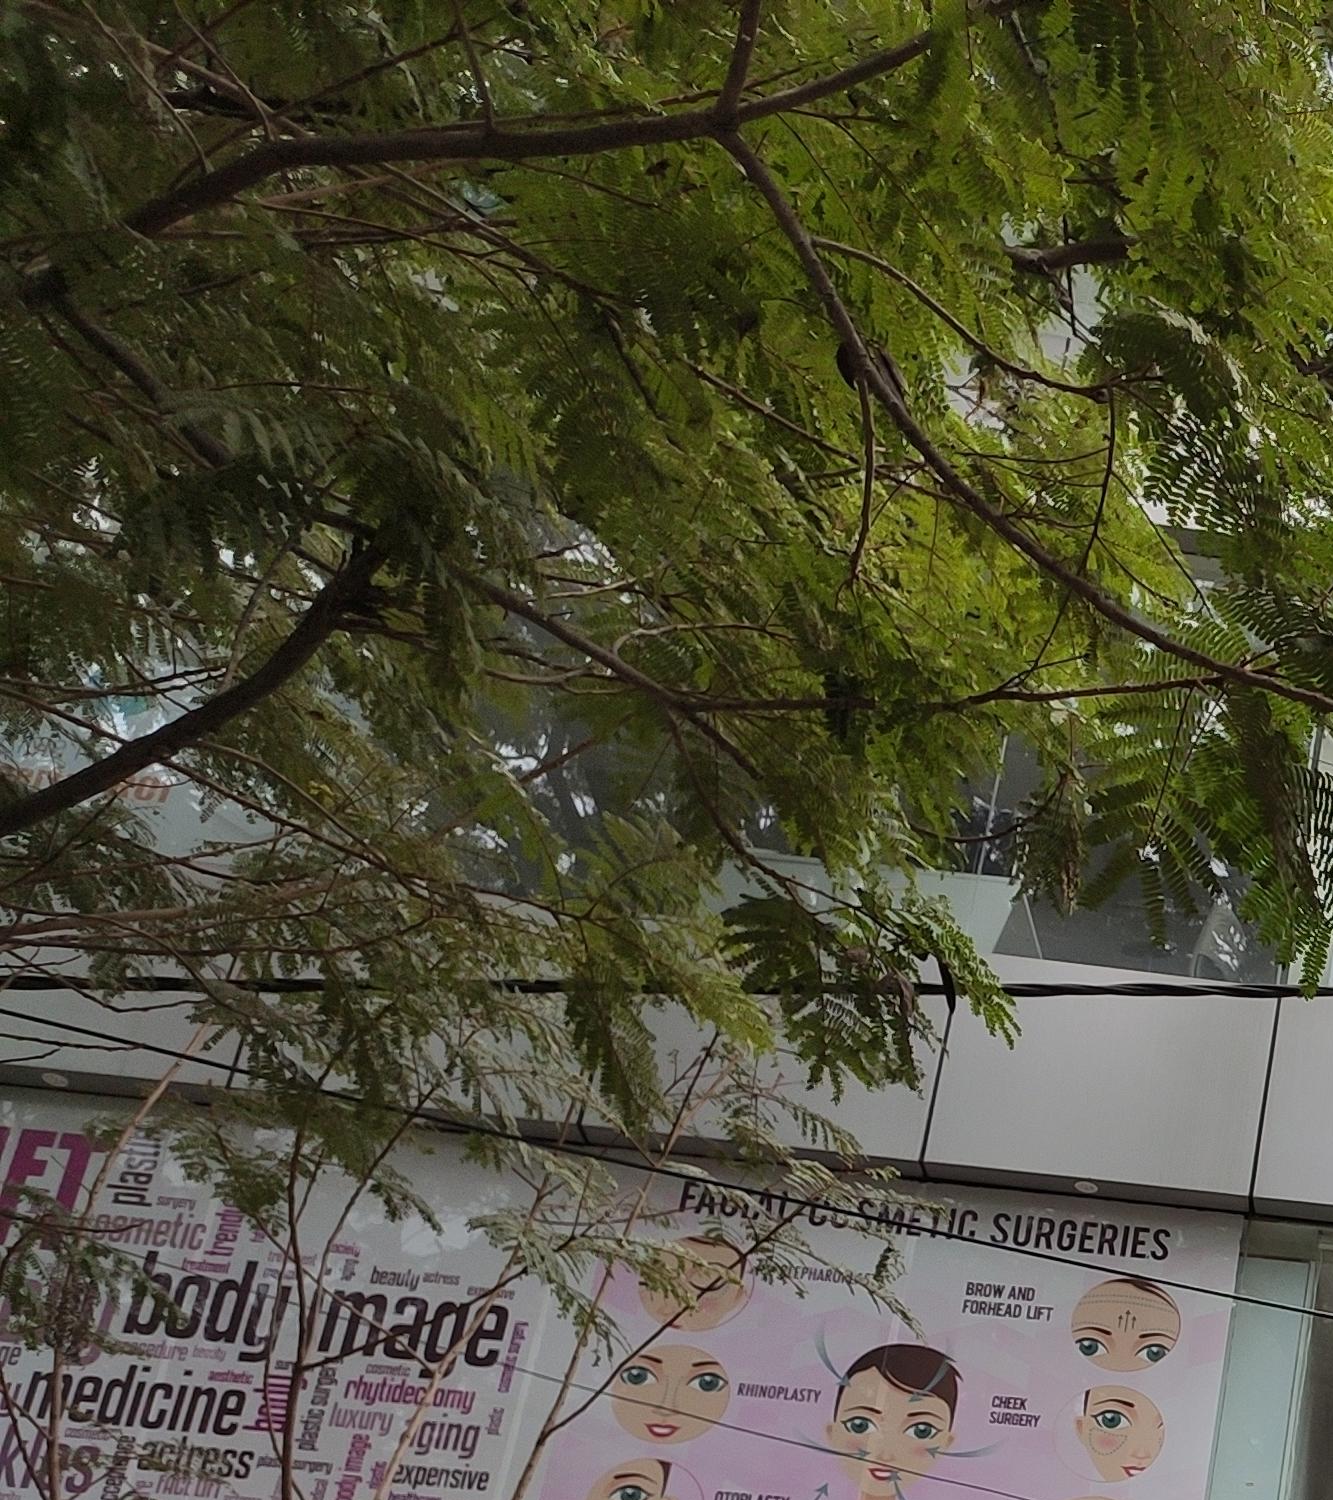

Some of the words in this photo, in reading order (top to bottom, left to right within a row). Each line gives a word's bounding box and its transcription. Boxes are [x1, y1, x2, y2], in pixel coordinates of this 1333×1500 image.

[990, 1212, 1172, 1261] SURGERIES
[369, 1265, 421, 1292] beauty
[965, 1281, 1005, 1299] BROW
[1007, 1285, 1036, 1302] AND
[961, 1300, 1022, 1319] FORHEAD
[1026, 1306, 1054, 1322] LIFT
[305, 1282, 509, 1378] mage
[22, 1364, 247, 1436] medicine
[344, 1375, 476, 1414] rhytidecomy
[737, 1381, 822, 1404] RHINOPLASTY
[991, 1395, 1027, 1411] CHEEK
[329, 1402, 394, 1437] luxury
[989, 1410, 1041, 1428] SURGERY
